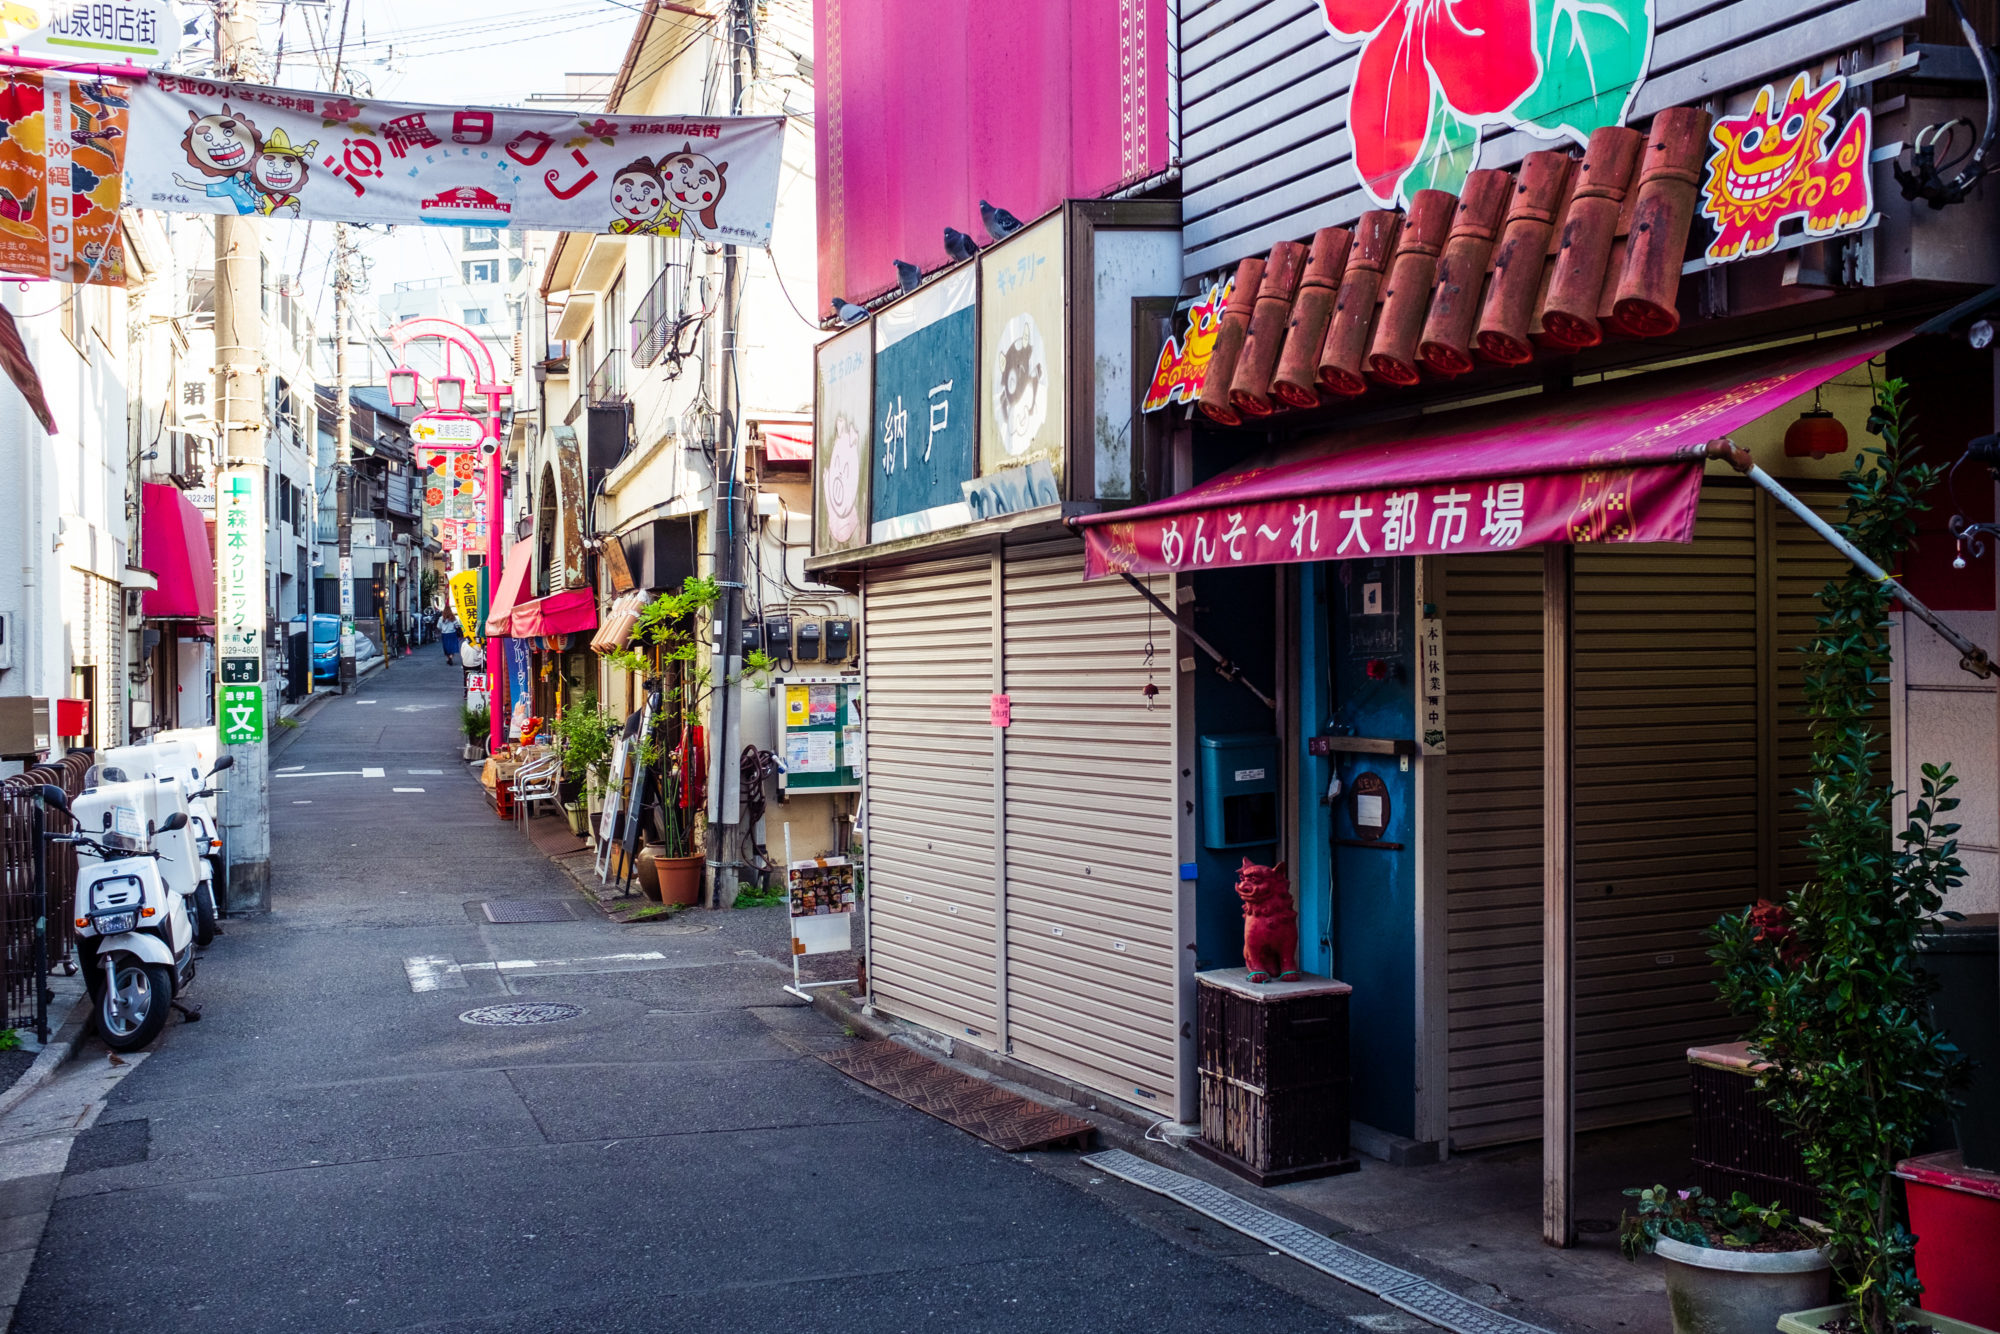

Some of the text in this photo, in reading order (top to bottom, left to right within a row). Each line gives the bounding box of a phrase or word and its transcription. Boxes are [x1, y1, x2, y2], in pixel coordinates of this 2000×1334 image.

[49, 0, 156, 44] 和泉明店街
[157, 73, 315, 114] 杉並の小さな沖縄
[629, 122, 722, 140] 和泉明店街
[407, 147, 523, 184] WELCOME
[48, 138, 71, 273] 沖縄タウン
[151, 192, 190, 204] ニライくん
[720, 225, 759, 239] カナイちゃん
[997, 253, 1047, 297] ギャラリー
[881, 378, 954, 476] 納戸
[226, 508, 248, 626] 森本クリニック
[462, 582, 478, 633] 全国発送
[1427, 627, 1442, 691] 本日休業
[226, 703, 256, 734] 文
